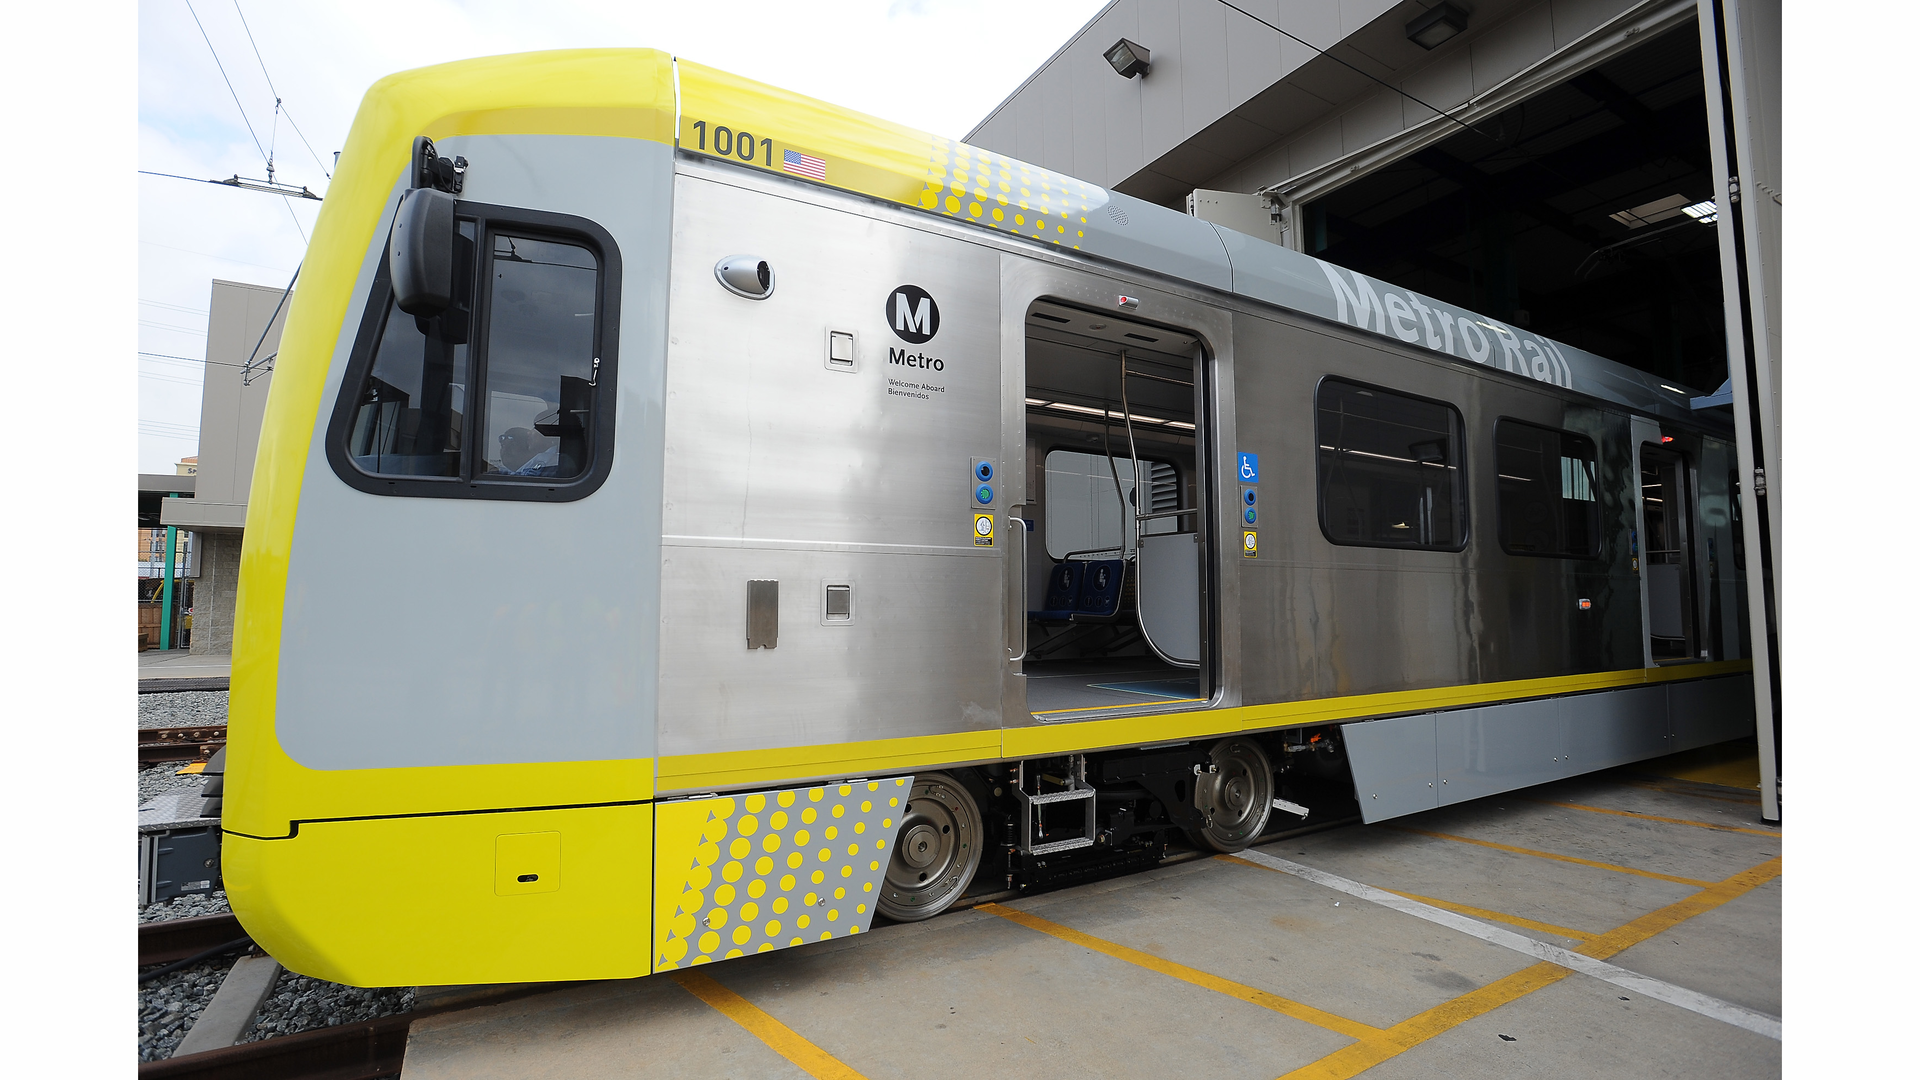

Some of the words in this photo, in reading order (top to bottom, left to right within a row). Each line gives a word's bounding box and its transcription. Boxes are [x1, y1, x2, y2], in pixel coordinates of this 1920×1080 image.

[693, 120, 773, 167] 1001
[896, 292, 930, 335] M
[1313, 257, 1492, 364] Metro
[1482, 314, 1573, 390] Rail
[889, 347, 944, 371] Metro
[888, 378, 919, 389] Welcome
[921, 383, 945, 393] Aboard
[888, 387, 929, 400] Bienvenidos
